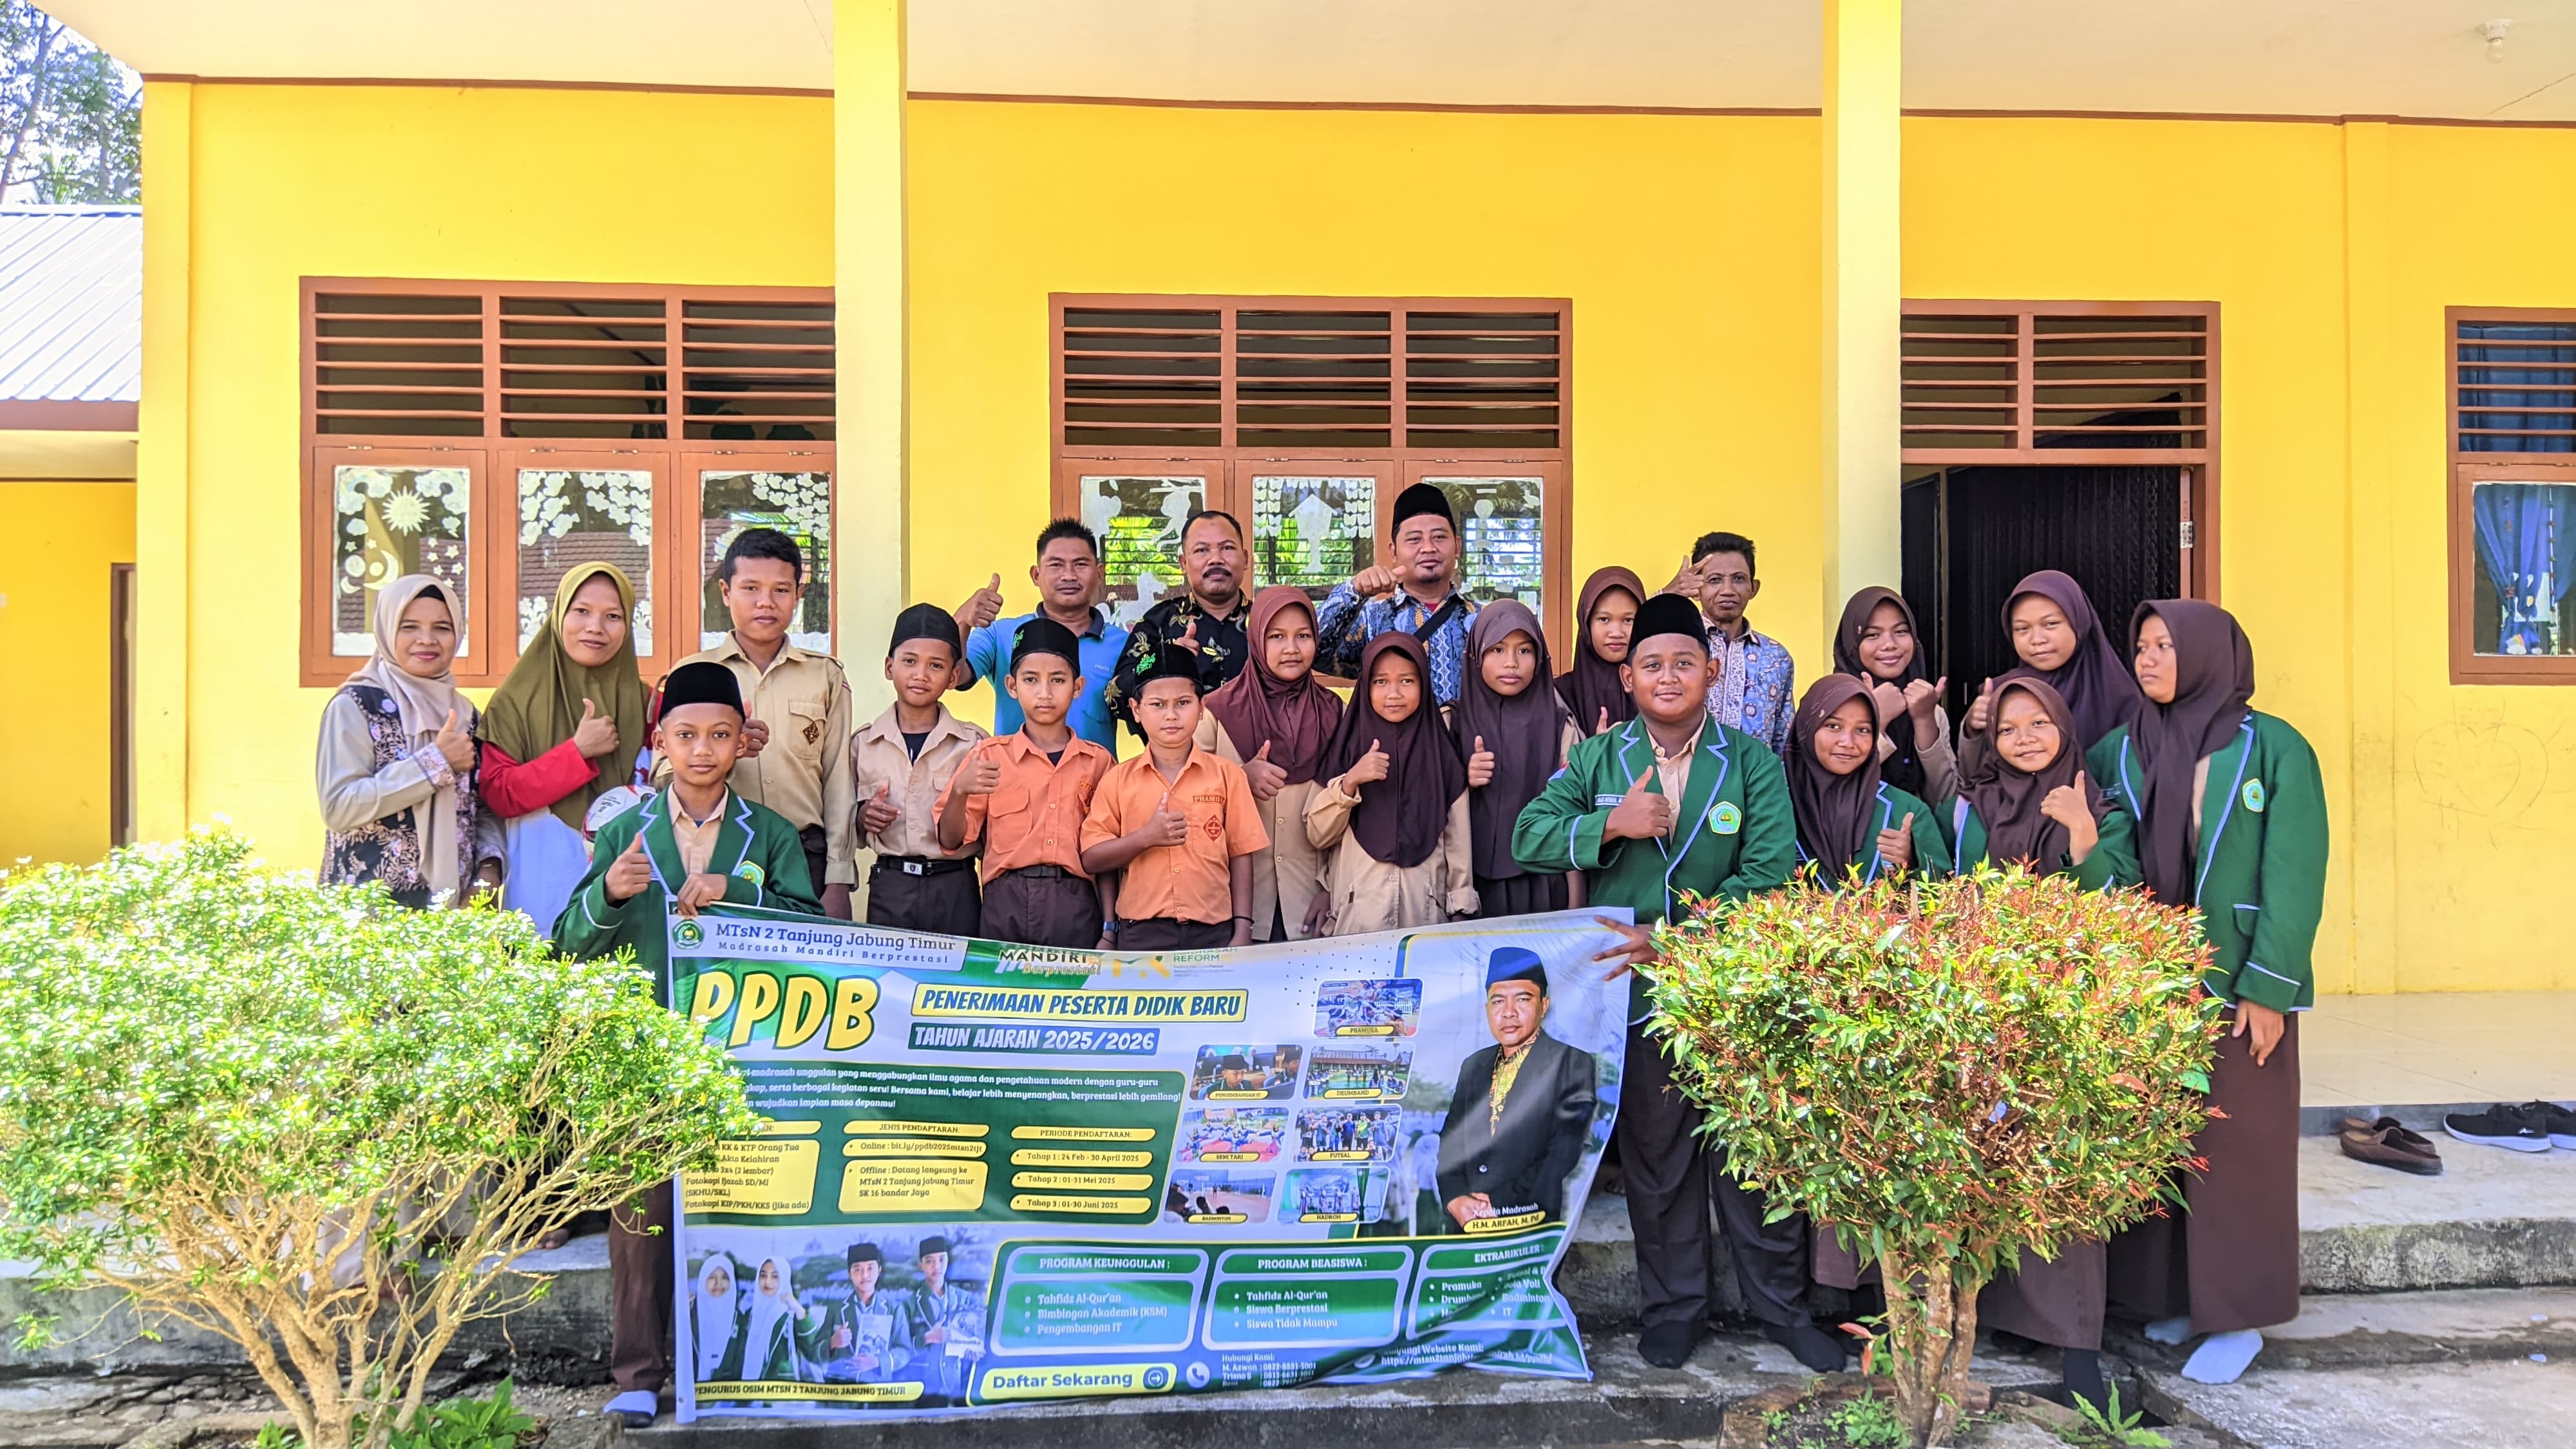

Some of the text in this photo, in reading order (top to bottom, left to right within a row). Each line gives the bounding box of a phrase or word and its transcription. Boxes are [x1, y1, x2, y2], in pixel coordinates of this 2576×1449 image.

[716, 923, 956, 951] MTsN 2 Tanjung Jabung Timur
[718, 942, 949, 963] Madrasah Mandiri Berprestasi
[999, 949, 1087, 963] MANDIRI
[1173, 954, 1220, 963] REFORM
[1022, 960, 1102, 977] Berprestasi
[922, 989, 1241, 1017] PENERIMAAN PESERTA DIDIK BARU
[689, 969, 881, 1052] PPDB
[914, 1027, 1155, 1052] TAHUN AJARAN 2025/2026
[797, 1069, 837, 1080] unggulan
[838, 1070, 858, 1080] yang
[860, 1070, 927, 1082] menggabungkan
[929, 1073, 948, 1082] ilmu
[949, 1074, 978, 1085] agama
[978, 1074, 994, 1083] dan
[996, 1075, 1050, 1086] pengetahuan
[1051, 1077, 1083, 1086] modern
[1084, 1077, 1115, 1088] dengan
[1116, 1078, 1159, 1088] guru-guru
[769, 1083, 791, 1092] serta
[792, 1083, 831, 1094] berbagai
[831, 1083, 868, 1094] kegiatan
[869, 1084, 889, 1094] seru!
[891, 1085, 927, 1095] Bersama
[928, 1086, 951, 1097] kami,
[952, 1088, 982, 1099] belajar
[983, 1089, 1003, 1098] lebih
[1005, 1091, 1070, 1102] menyenangkan,
[1071, 1091, 1118, 1102] berprestasi
[1118, 1092, 1139, 1101] lebih
[1141, 1092, 1181, 1103] gemilang!
[755, 1099, 798, 1110] wujudkan
[799, 1099, 829, 1109] impian
[855, 1099, 896, 1110] depanmu!
[758, 1144, 783, 1153] Orang
[1027, 1153, 1051, 1161] Tahap
[1101, 1154, 1121, 1162] April
[734, 1166, 743, 1175] (2
[743, 1167, 774, 1175] lembar)
[892, 1166, 920, 1175] Datang
[922, 1166, 957, 1175] langsung
[685, 1177, 769, 1187] Fotokopi Ijazah SD/MI
[889, 1178, 922, 1187] Tanjung
[922, 1178, 950, 1187] Jabung
[1028, 1175, 1052, 1184] Tahap
[685, 1189, 731, 1197] (SKHU/SKL)
[911, 1189, 930, 1198] Jaya
[685, 1200, 720, 1209] Fotokopi
[772, 1200, 790, 1211] (jika
[791, 1200, 810, 1210] ada)
[1027, 1198, 1051, 1208] Tahap
[1474, 1202, 1539, 1217] Kepala Madrasah
[1316, 1213, 1342, 1222] HADROH
[1039, 1258, 1165, 1269] PROGRAM KEUNGGULAN
[1257, 1258, 1363, 1269] PROGRAM BEASISWA
[1441, 1281, 1482, 1292] Pramuka
[1037, 1294, 1075, 1305] Tahfidz
[1283, 1290, 1328, 1301] Al-Qur'an
[1037, 1308, 1089, 1320] Bimbingan
[1091, 1307, 1139, 1318] Akademik
[1246, 1303, 1328, 1315] Siswa Berprestasi
[1502, 1307, 1512, 1316] IT
[1037, 1322, 1122, 1335] Pengembangan IT
[1246, 1318, 1338, 1329] Siswa Tidak Mampu
[1421, 1344, 1457, 1354] Website
[1458, 1343, 1484, 1352] Kami:
[1222, 1353, 1253, 1363] Hubungi
[992, 1373, 1133, 1389] Daftar Sekarang
[743, 1385, 765, 1393] OSIM
[799, 1387, 838, 1395] TANJUNG
[840, 1387, 876, 1396] JABUNG
[876, 1387, 906, 1396] TIMUR
